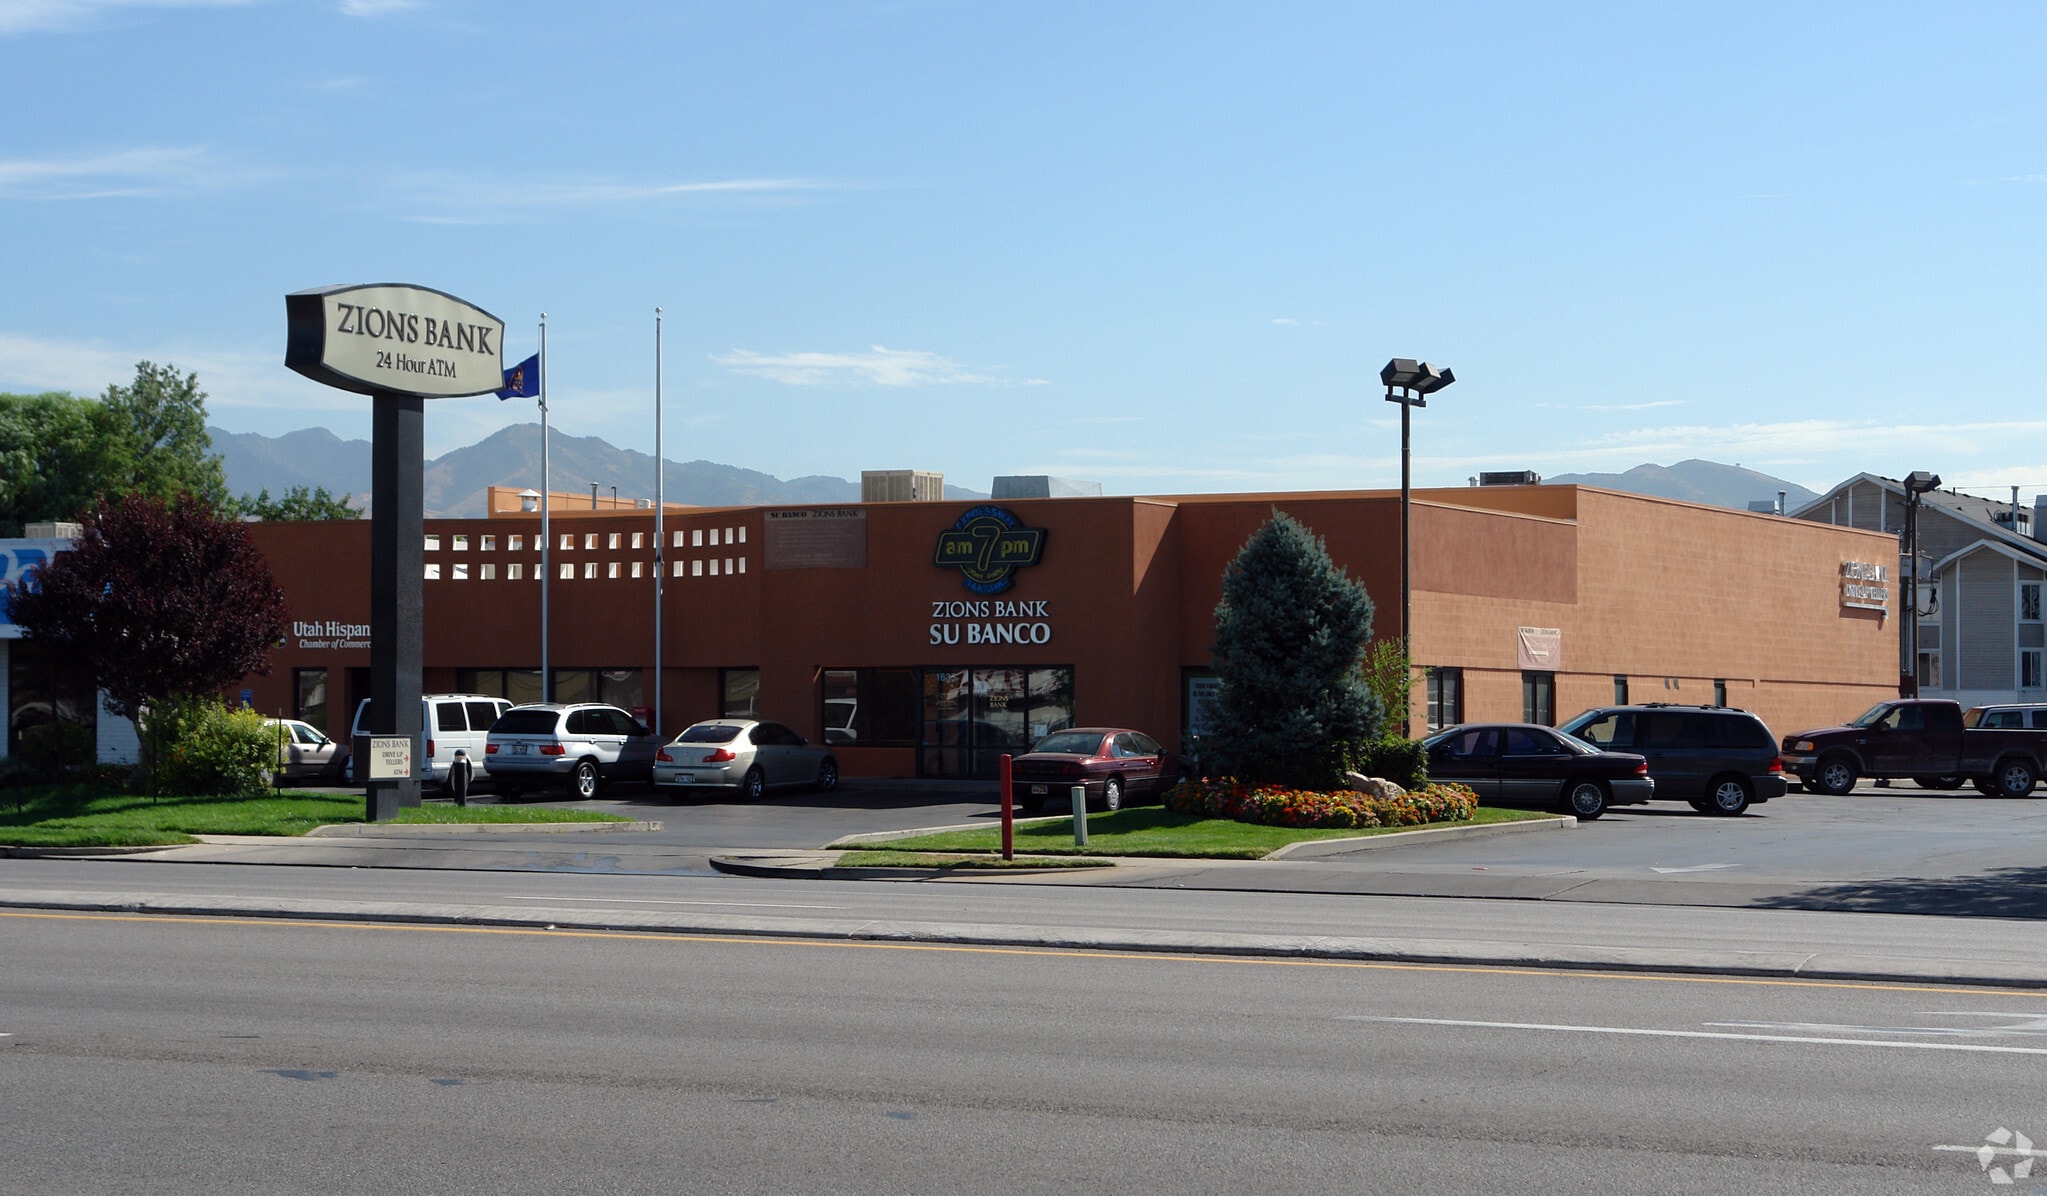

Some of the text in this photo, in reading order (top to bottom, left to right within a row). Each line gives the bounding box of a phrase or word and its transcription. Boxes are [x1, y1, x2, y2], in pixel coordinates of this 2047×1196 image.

[337, 303, 494, 355] ZIONS BANK
[376, 350, 457, 378] 24 Hour ATM
[945, 525, 1030, 572] am 7 pm
[932, 600, 1049, 618] ZIONS BANK
[293, 621, 371, 640] Utah Hispan
[930, 622, 1051, 645] SU BANCO
[299, 639, 330, 648] Chamber
[331, 639, 340, 650] of
[372, 740, 409, 748] ZIONS BANK
